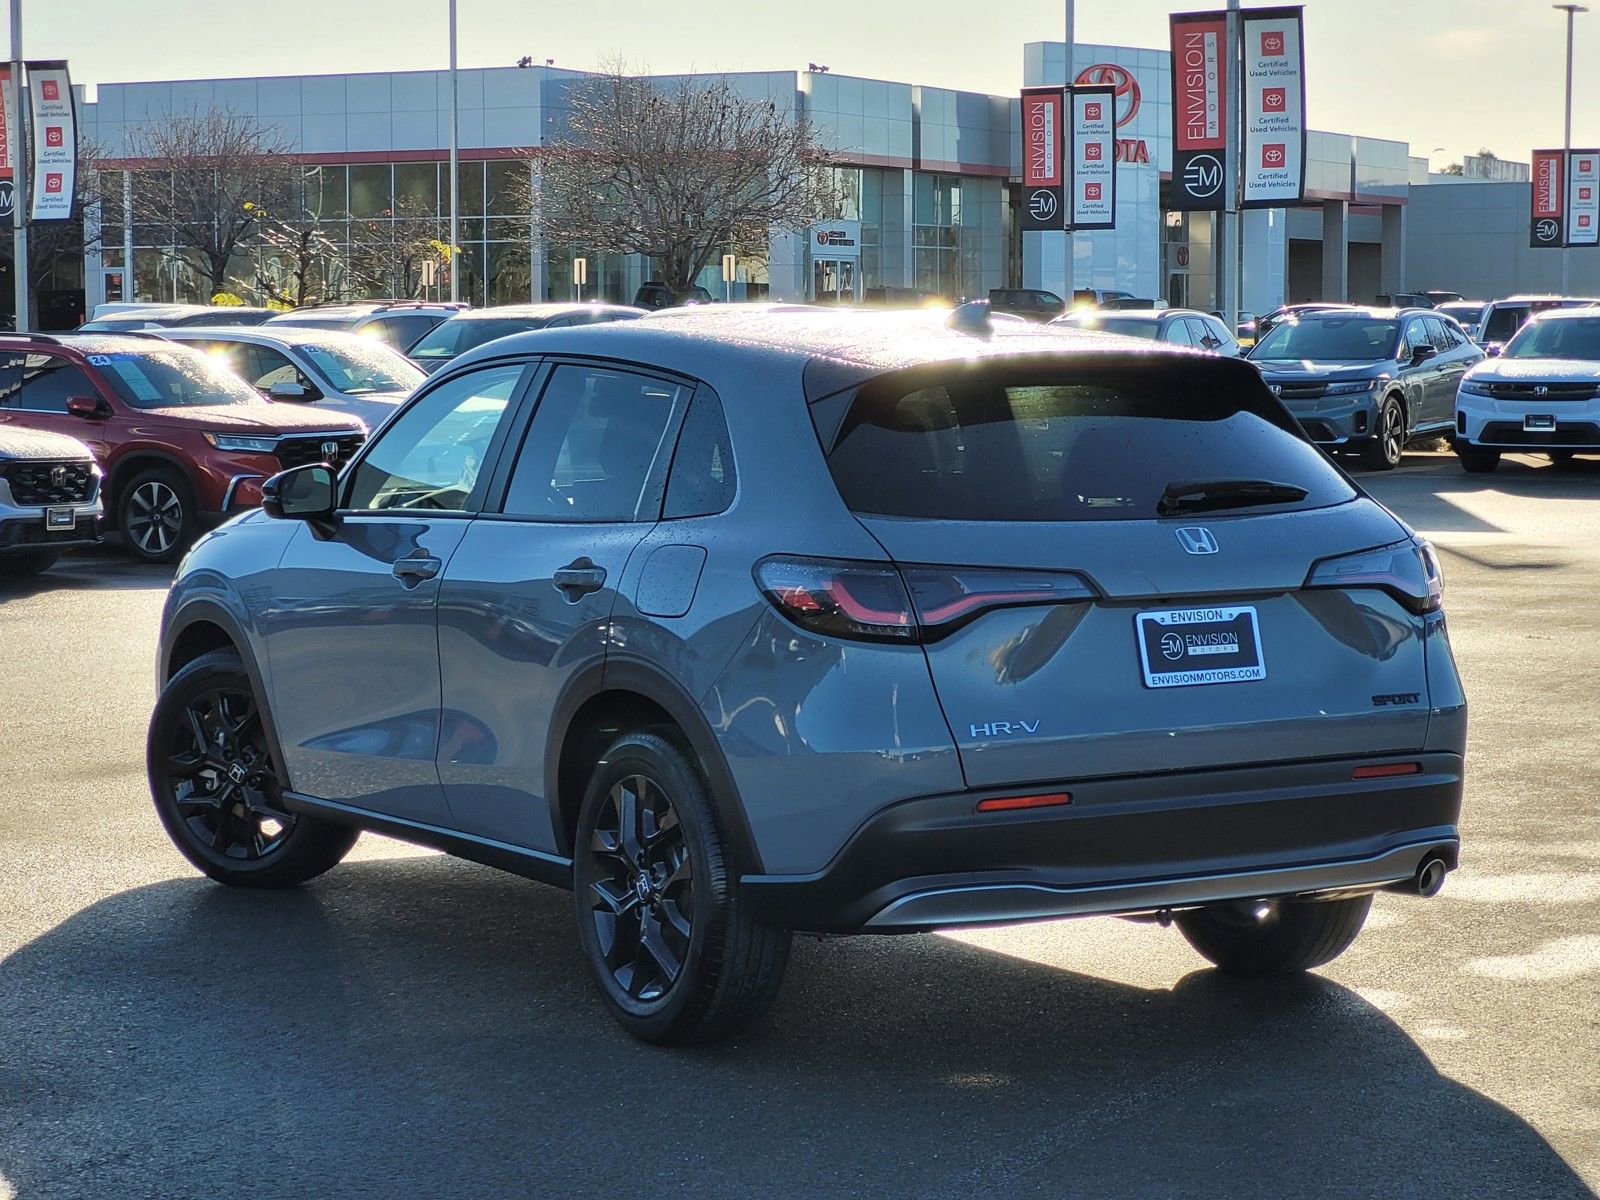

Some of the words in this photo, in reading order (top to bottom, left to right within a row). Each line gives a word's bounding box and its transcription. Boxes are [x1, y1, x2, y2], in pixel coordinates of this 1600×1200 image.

[1185, 32, 1204, 140] ENVISION
[1208, 41, 1216, 130] MOTORS
[1031, 102, 1044, 179] ENVISION
[1257, 172, 1288, 180] Certified
[1538, 159, 1549, 212] ENVISION
[91, 356, 108, 364] 24
[1171, 610, 1223, 623] ENVISION
[1185, 632, 1238, 647] ENVISION
[1192, 645, 1235, 653] MOTORS
[1151, 669, 1260, 685] ENVISIONMOTORS.COM
[1371, 692, 1421, 706] SPORT
[970, 719, 1040, 737] HR-V
